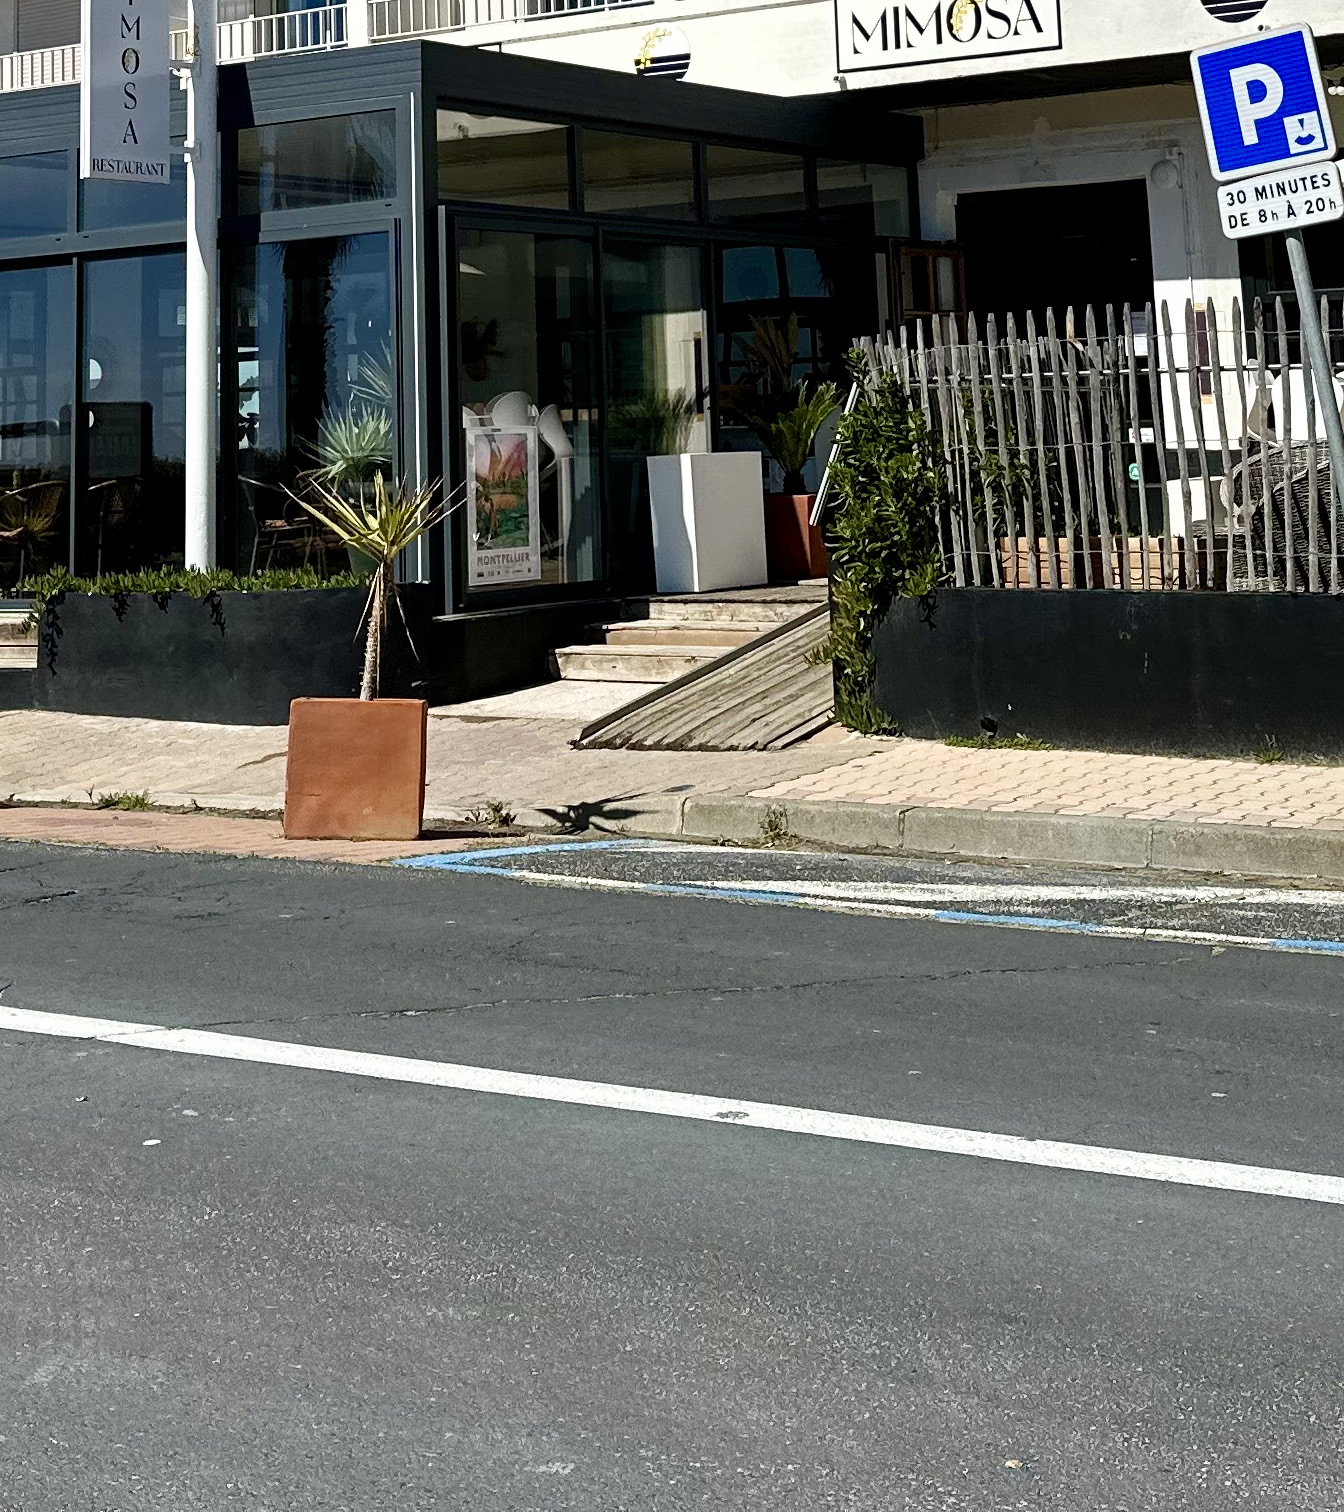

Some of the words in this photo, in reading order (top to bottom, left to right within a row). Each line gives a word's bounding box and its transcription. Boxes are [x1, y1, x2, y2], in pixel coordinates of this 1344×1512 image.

[1229, 62, 1284, 146] P
[92, 157, 166, 177] RESTAURANT
[1225, 190, 1247, 207] 30
[1255, 173, 1331, 201] MINUTES
[1228, 212, 1250, 229] DE
[1258, 209, 1279, 223] 8h
[1286, 199, 1297, 219] À
[1305, 197, 1337, 215] 20h
[477, 551, 531, 566] MONTPELLIER
